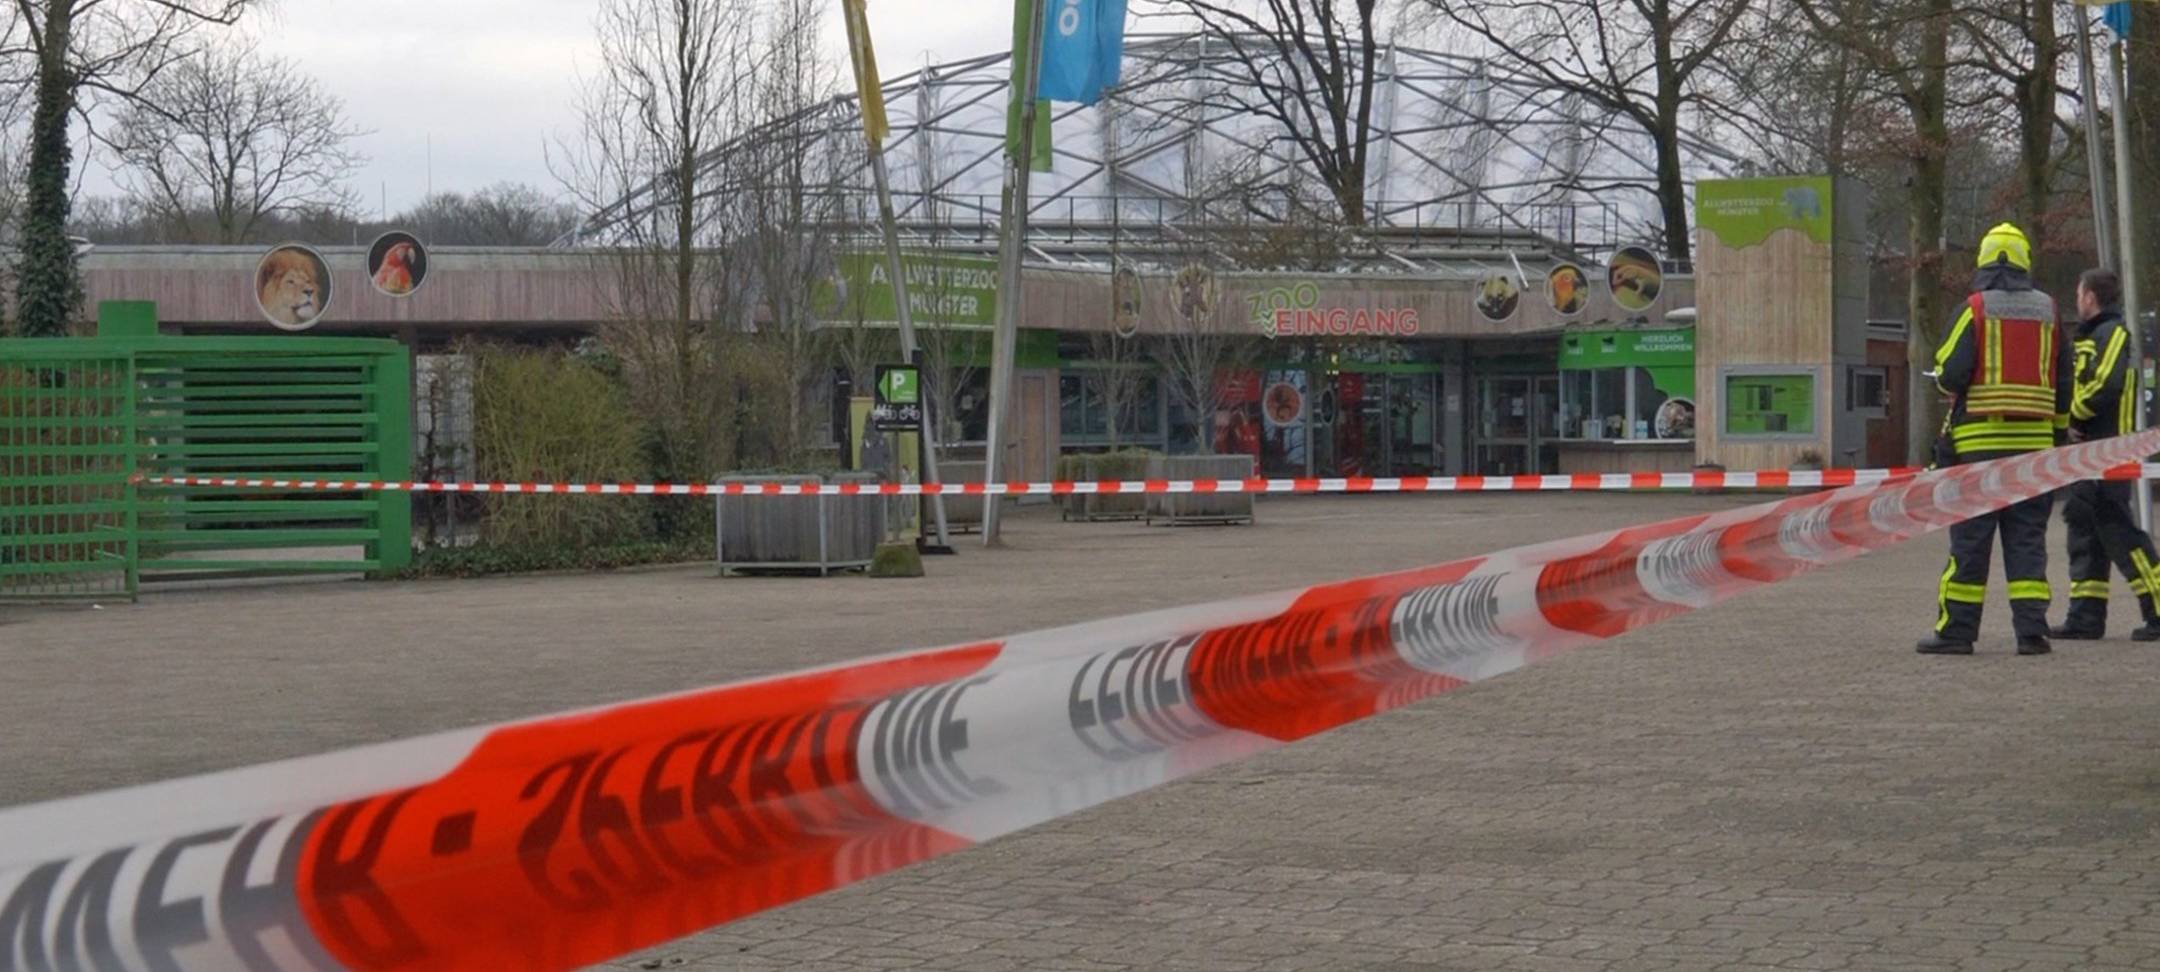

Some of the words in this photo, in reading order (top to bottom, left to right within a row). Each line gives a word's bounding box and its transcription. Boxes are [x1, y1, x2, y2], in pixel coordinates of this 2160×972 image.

[1248, 281, 1319, 323] ZOO
[1274, 307, 1418, 336] EINGANG
[893, 372, 905, 390] P
